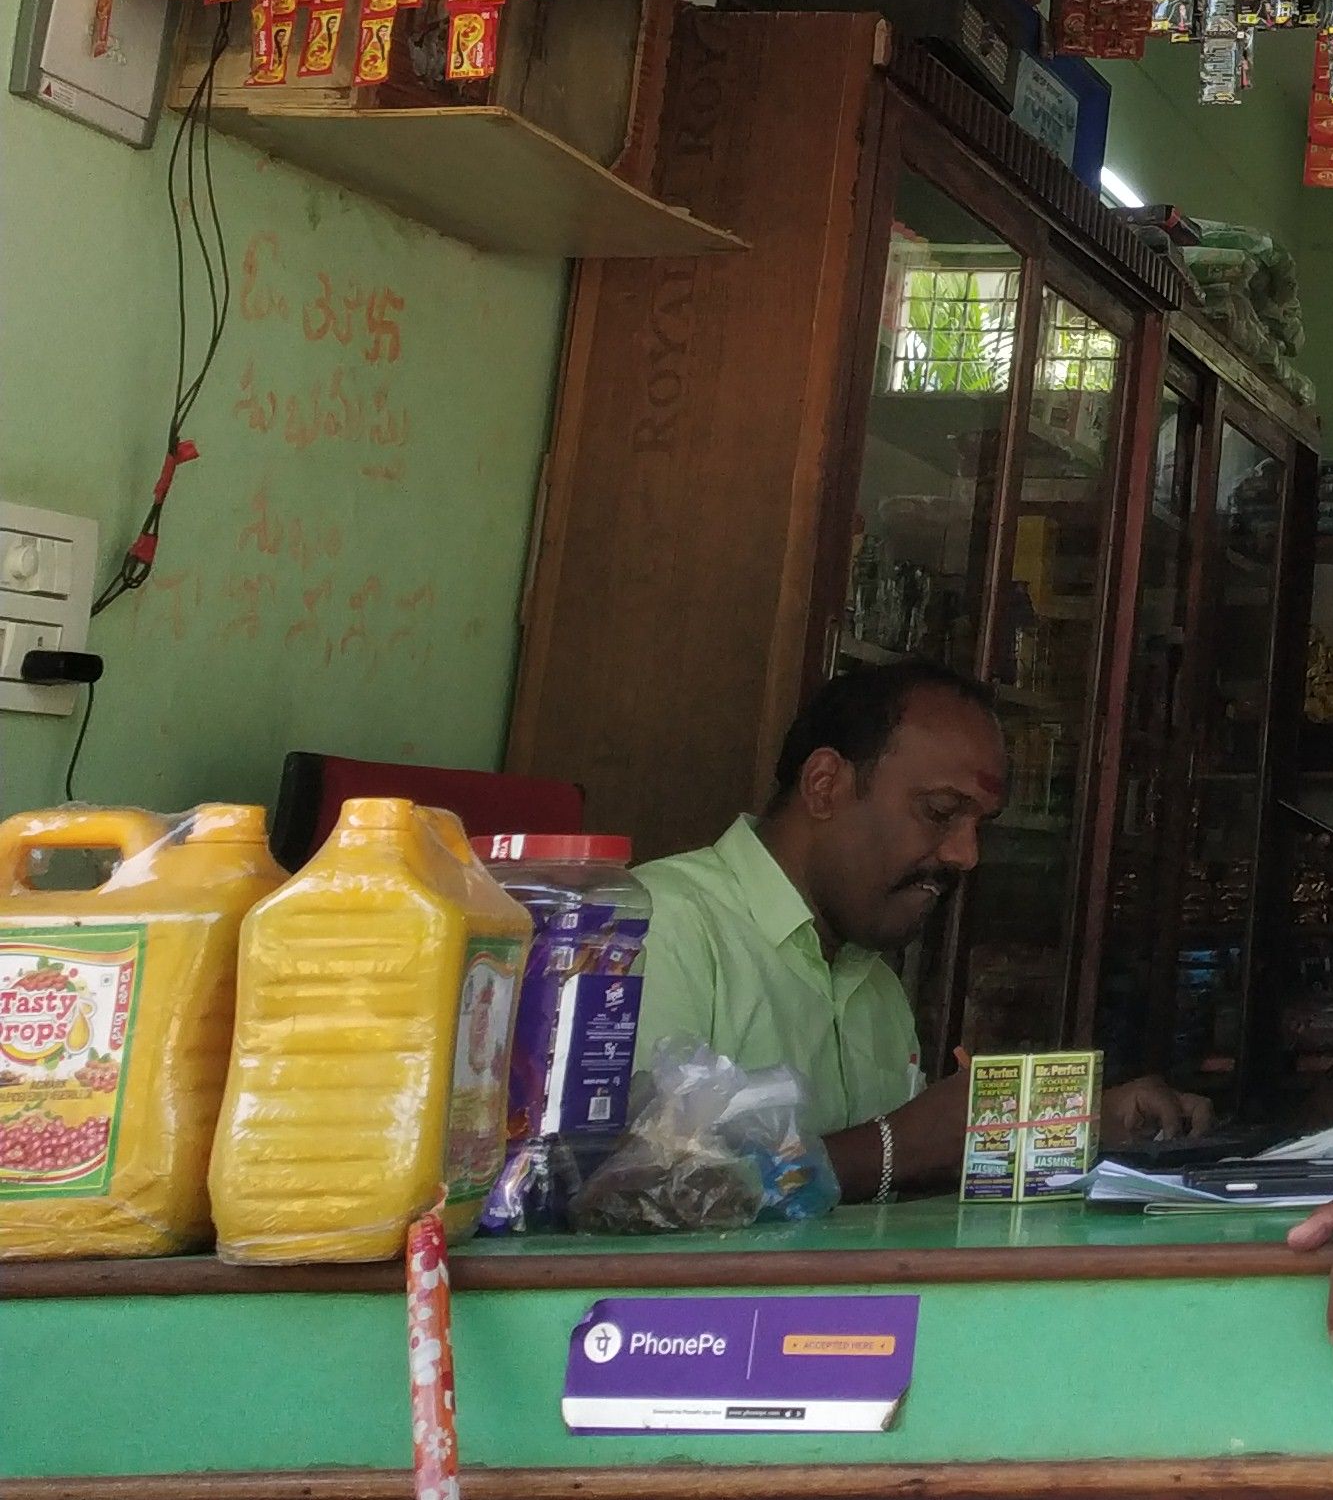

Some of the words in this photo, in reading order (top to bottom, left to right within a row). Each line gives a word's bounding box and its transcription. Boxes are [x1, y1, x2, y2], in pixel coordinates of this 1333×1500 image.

[0, 991, 78, 1020] Tasty
[1035, 1156, 1077, 1168] JASMINE
[629, 1331, 727, 1356] PhonePe
